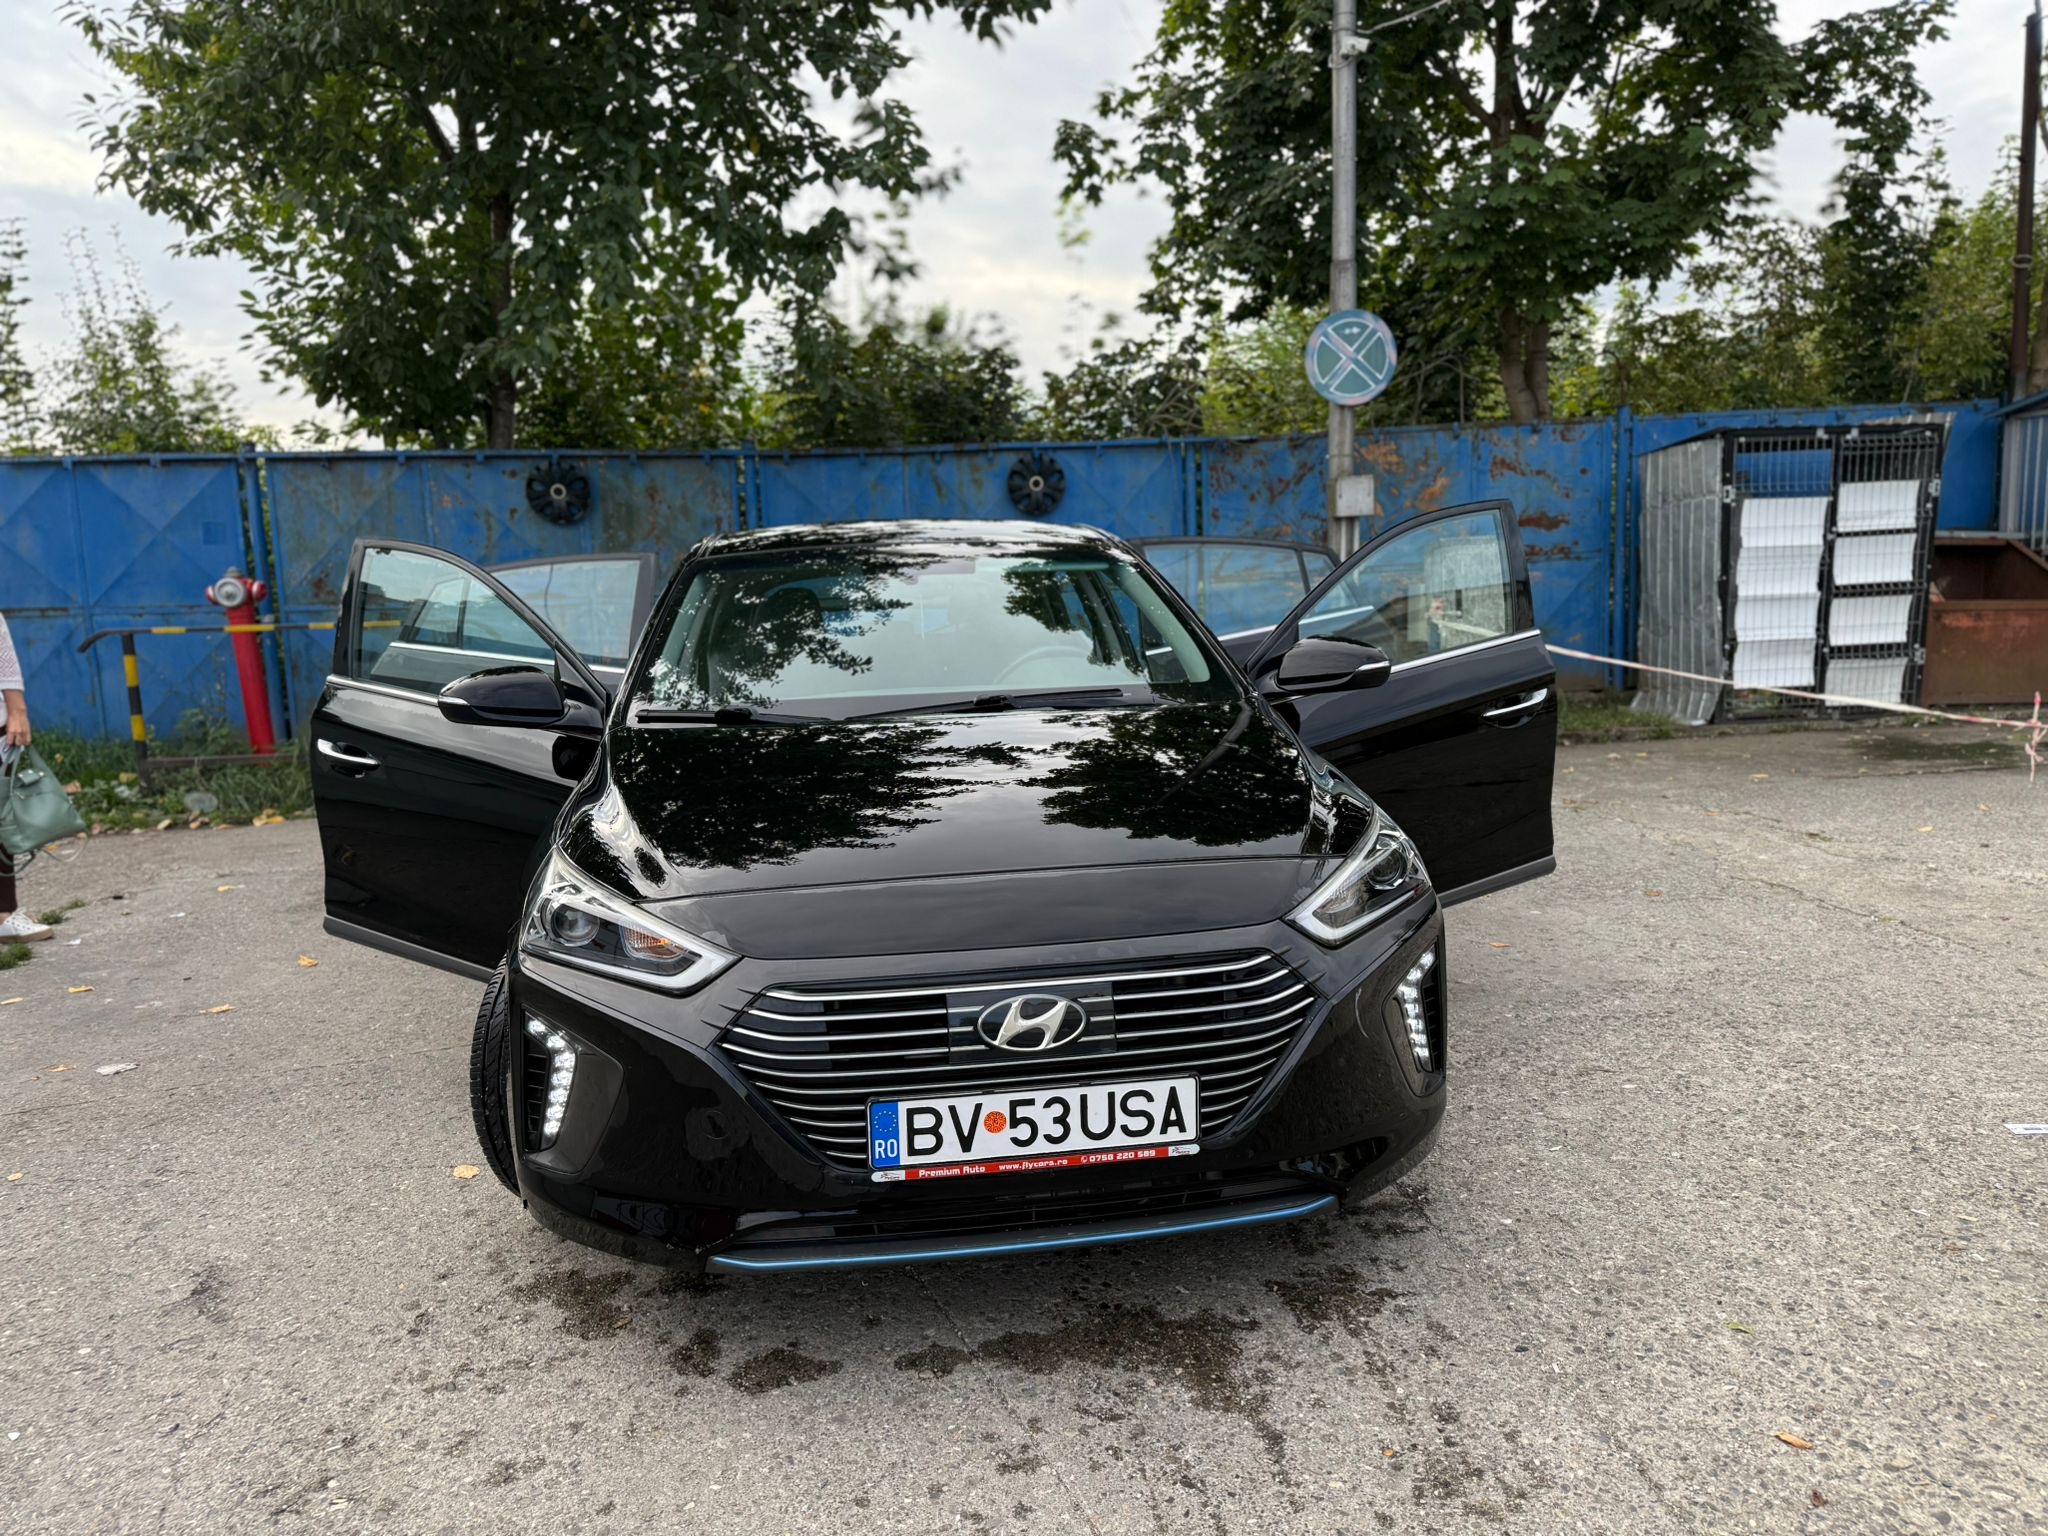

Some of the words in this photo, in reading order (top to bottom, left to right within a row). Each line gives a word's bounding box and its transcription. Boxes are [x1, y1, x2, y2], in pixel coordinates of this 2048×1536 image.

[906, 1102, 983, 1157] BV
[875, 1139, 898, 1159] RO
[919, 1168, 960, 1177] Premium
[963, 1165, 986, 1175] Auto
[999, 1159, 1067, 1170] www.flycars.ro
[1117, 1152, 1134, 1160] 220
